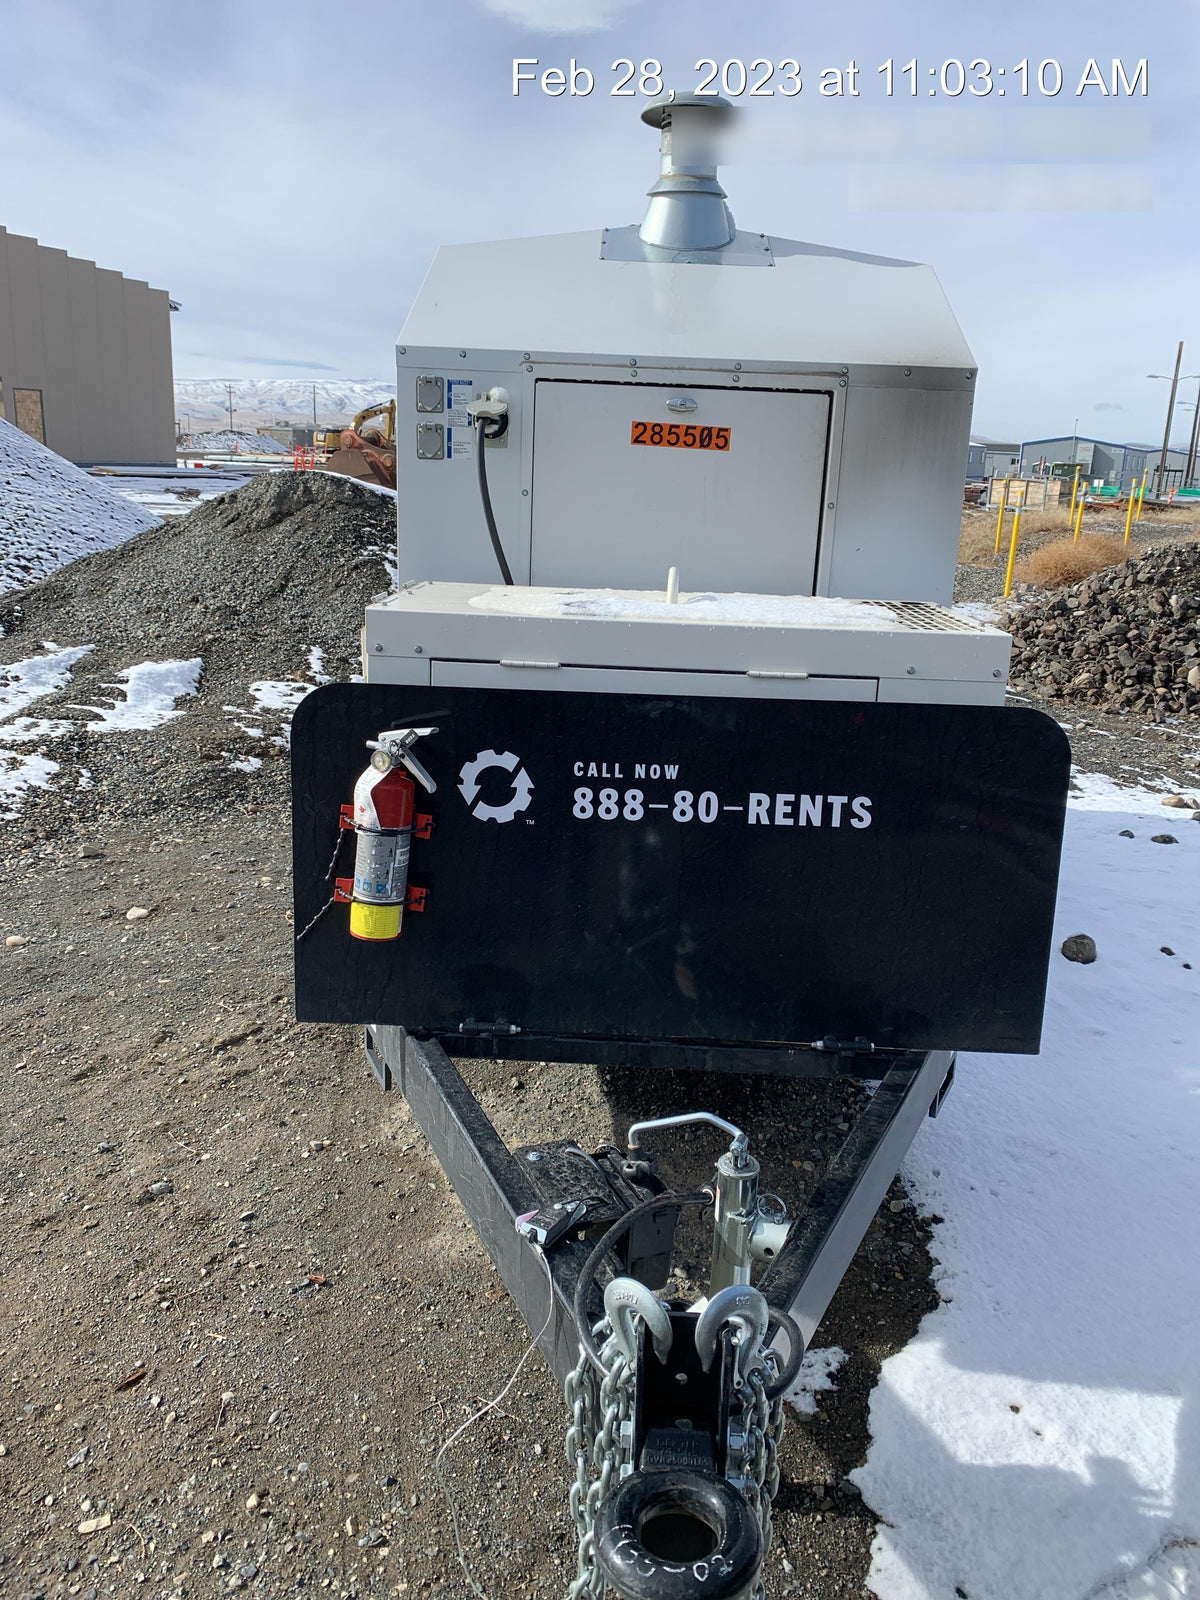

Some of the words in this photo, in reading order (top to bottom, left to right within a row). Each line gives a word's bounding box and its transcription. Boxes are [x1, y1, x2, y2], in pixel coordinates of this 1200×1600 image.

[632, 421, 730, 450] 285505
[573, 761, 624, 778] CALL
[634, 763, 680, 780] NOW
[572, 786, 873, 829] 888-80-RENTS
